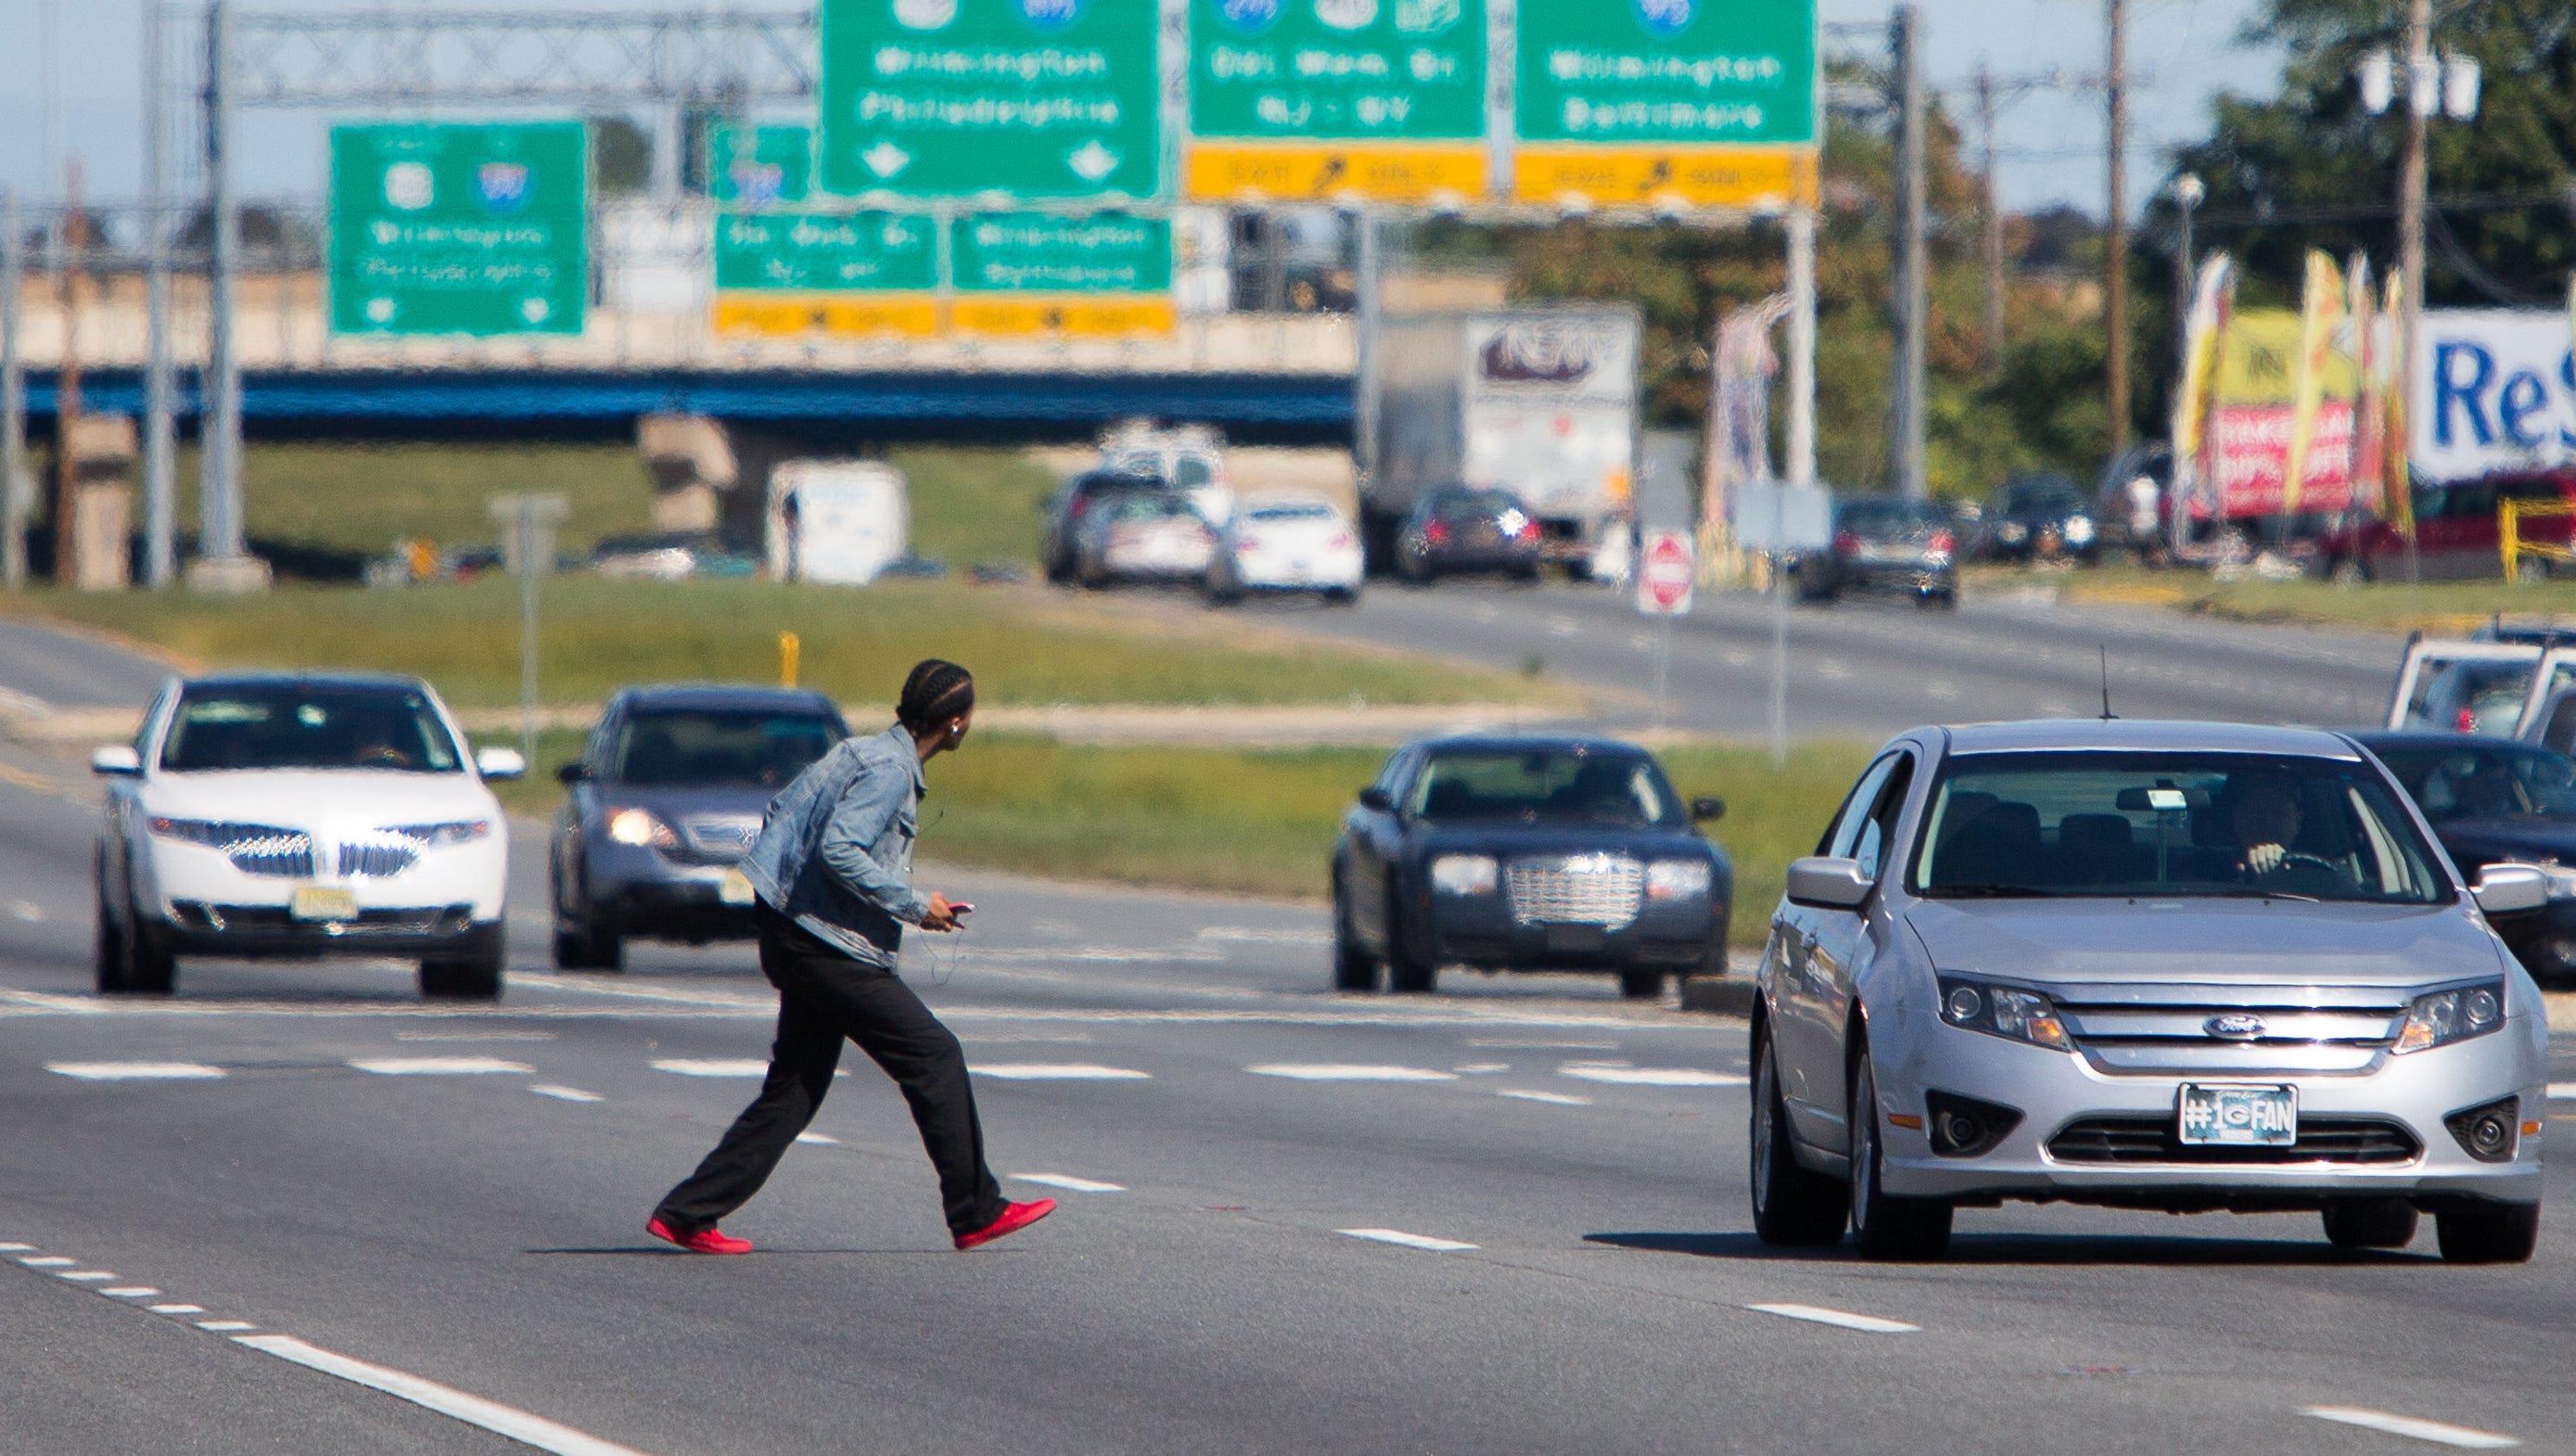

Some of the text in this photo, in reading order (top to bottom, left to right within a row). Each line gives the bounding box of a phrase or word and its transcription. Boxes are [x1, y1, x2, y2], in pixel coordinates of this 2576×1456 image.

[1549, 50, 1782, 87] Wilmington
[1563, 97, 1764, 131] Baltimore
[2218, 1016, 2257, 1032] Ford
